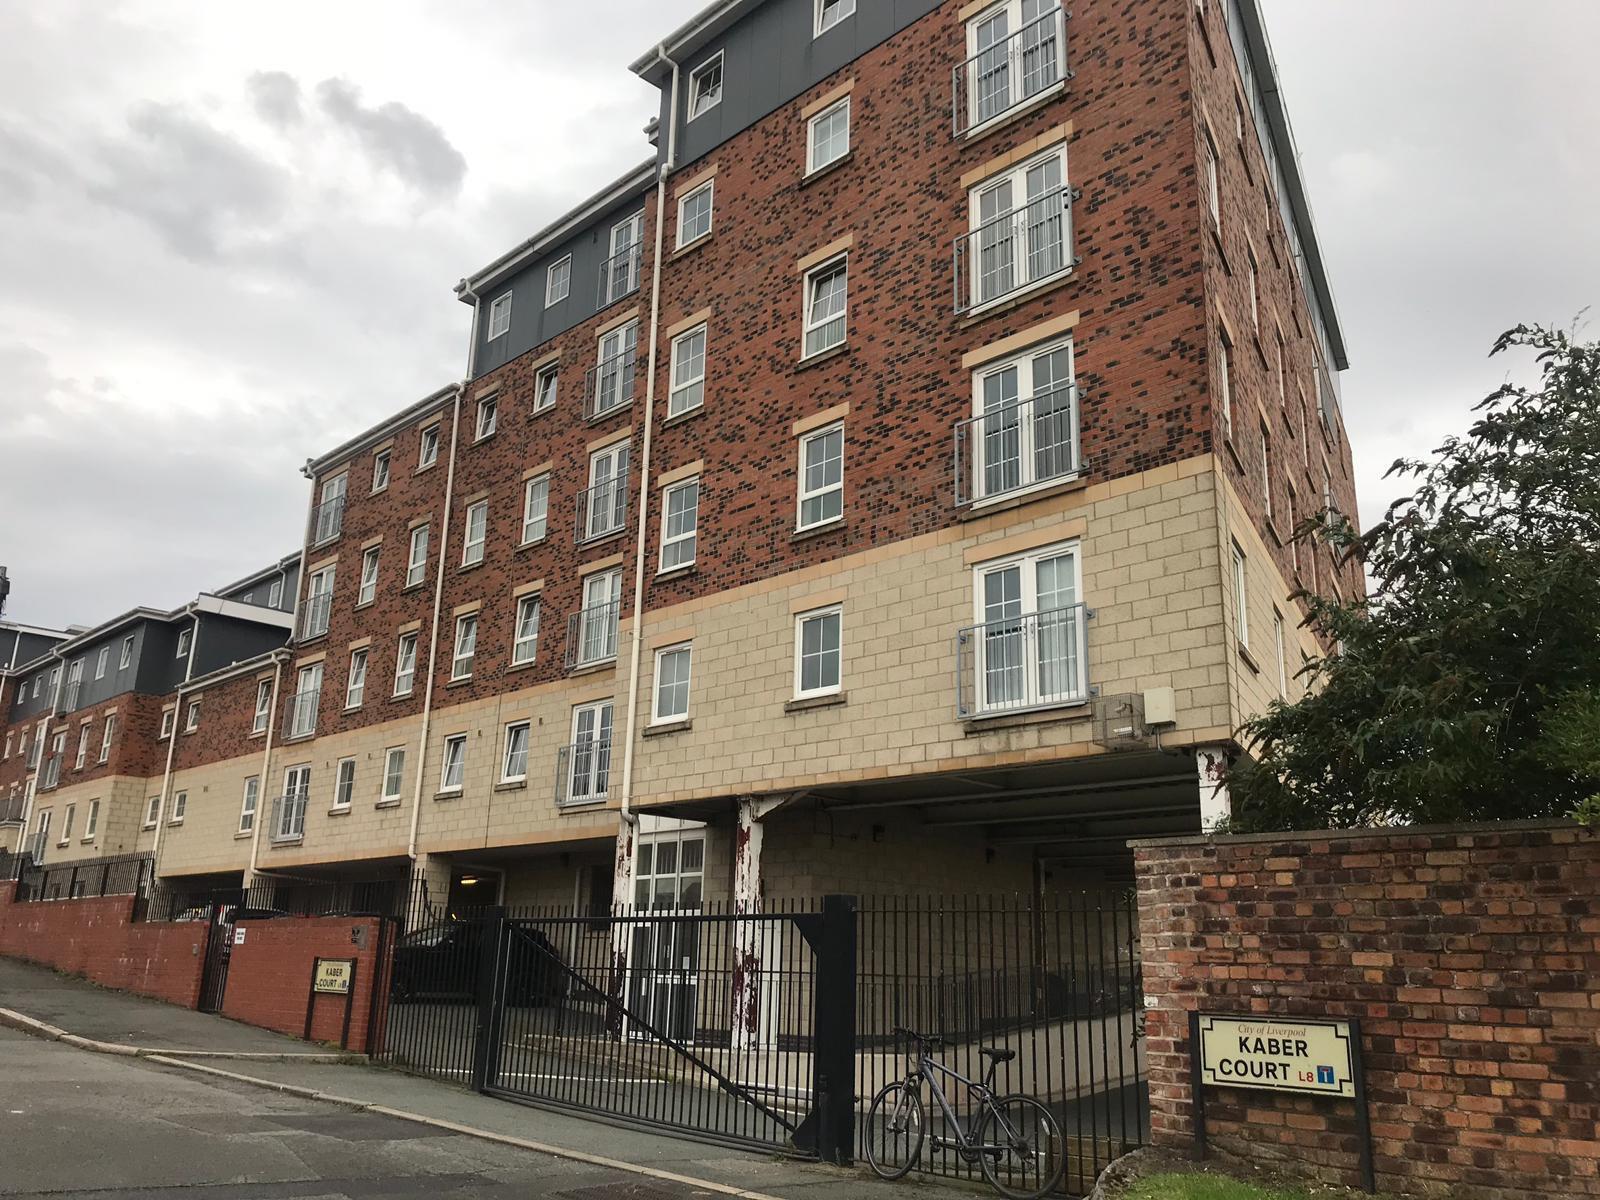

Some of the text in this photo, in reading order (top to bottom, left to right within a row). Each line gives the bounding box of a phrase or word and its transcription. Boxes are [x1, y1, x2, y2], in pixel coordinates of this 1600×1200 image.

[326, 968, 343, 976] KABER
[320, 979, 337, 988] COURT
[1238, 1024, 1307, 1037] City of Liverpool
[1239, 1036, 1308, 1057] KABER
[1219, 1058, 1314, 1082] COURT L8
